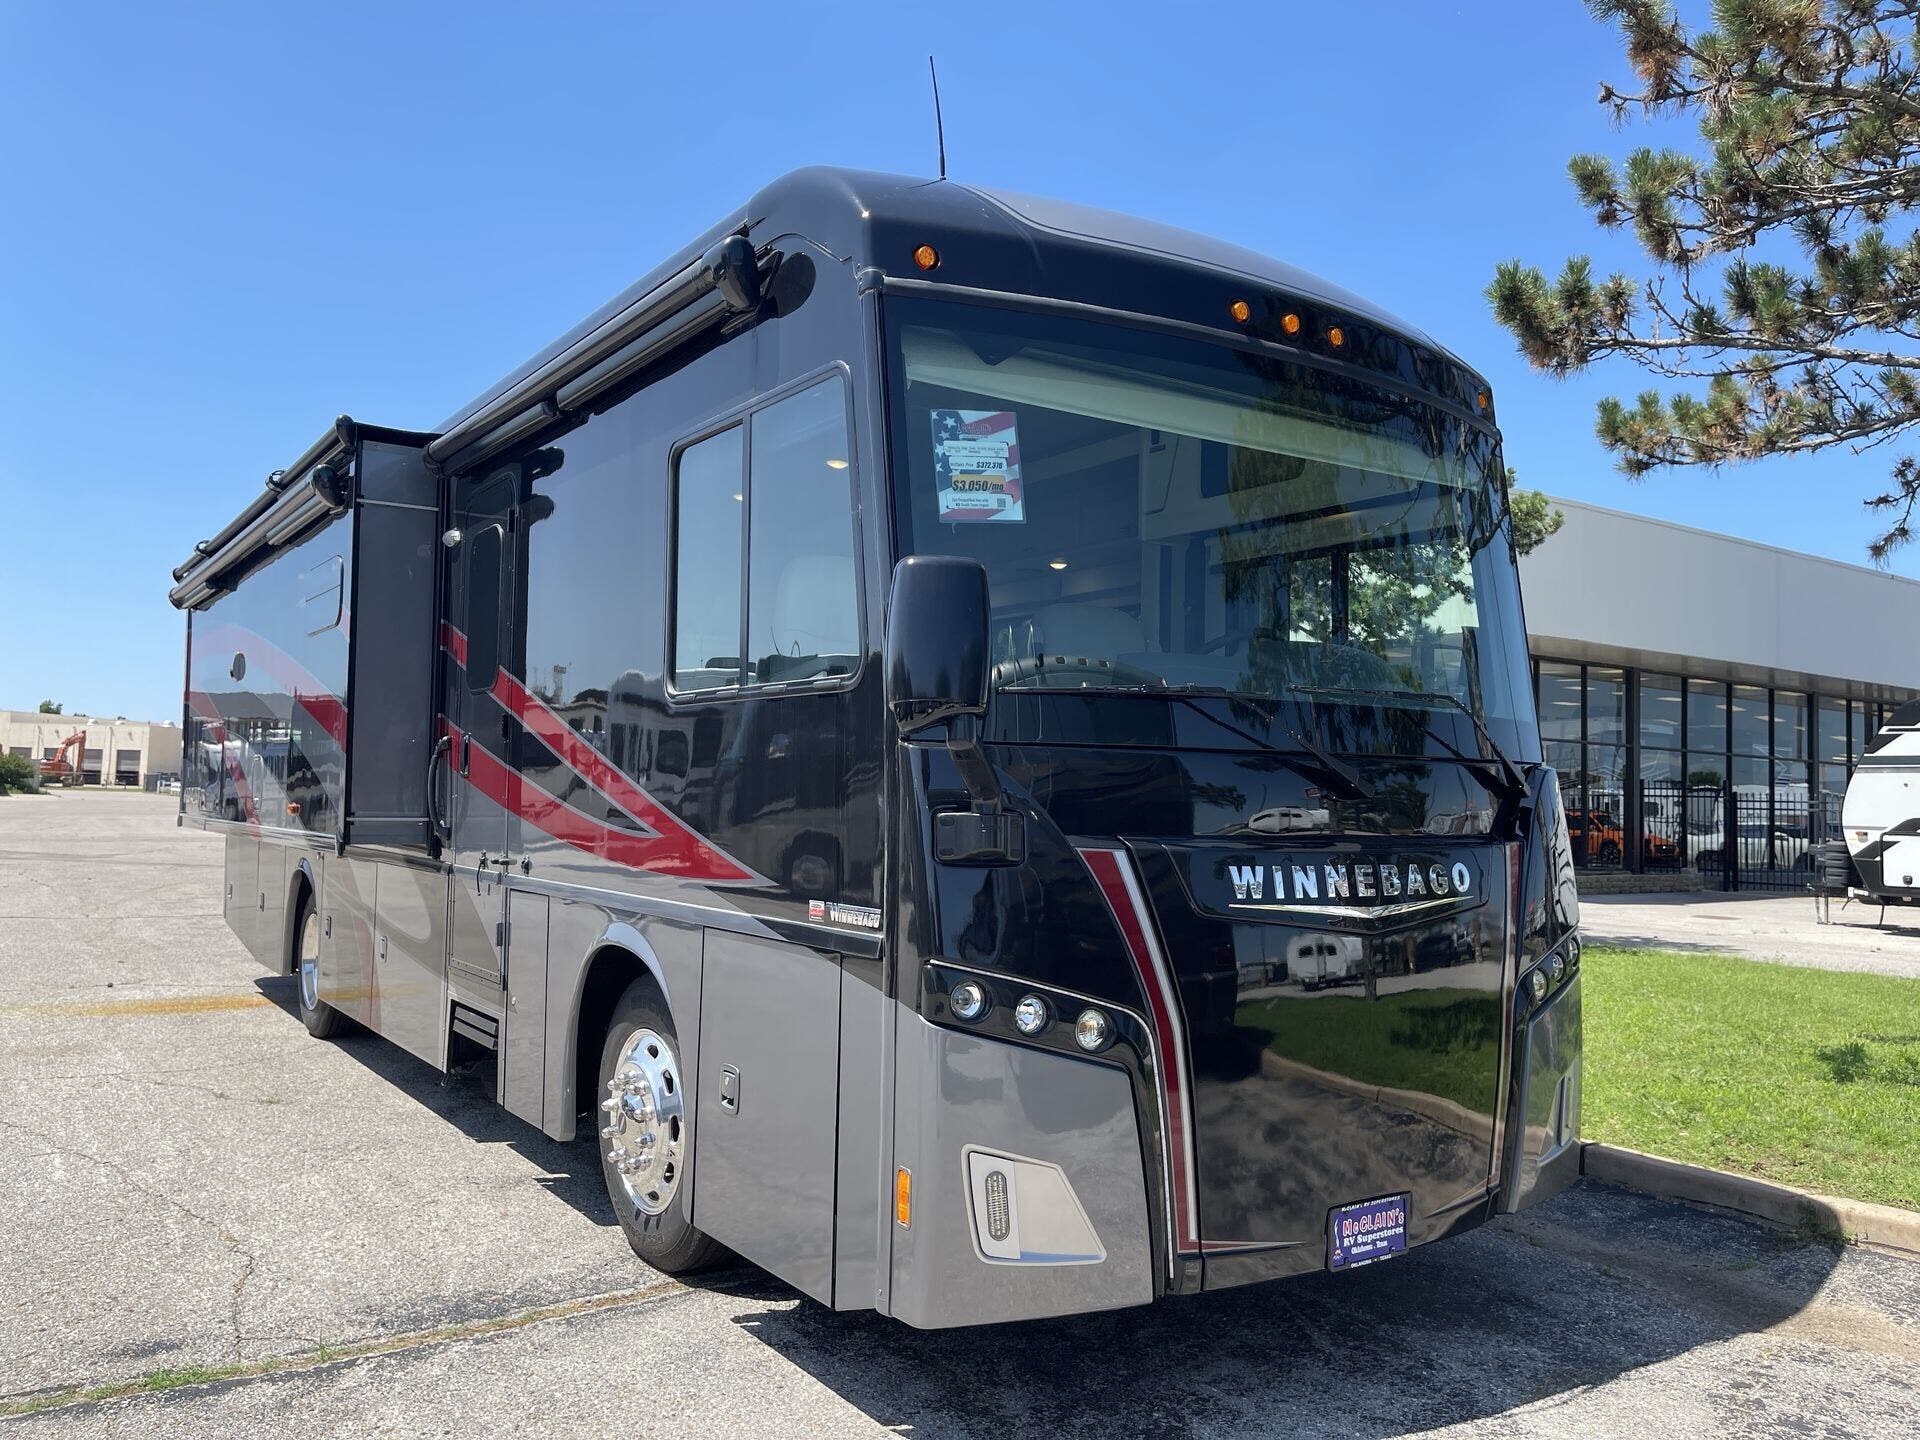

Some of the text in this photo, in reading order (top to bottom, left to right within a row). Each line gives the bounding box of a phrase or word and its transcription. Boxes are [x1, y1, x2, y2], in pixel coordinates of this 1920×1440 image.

[952, 480, 1004, 491] $3,050/mo
[1229, 861, 1470, 899] WINNEBAGO
[829, 906, 880, 928] WINNEBAGO
[1344, 1227, 1403, 1246] RV Superstores
